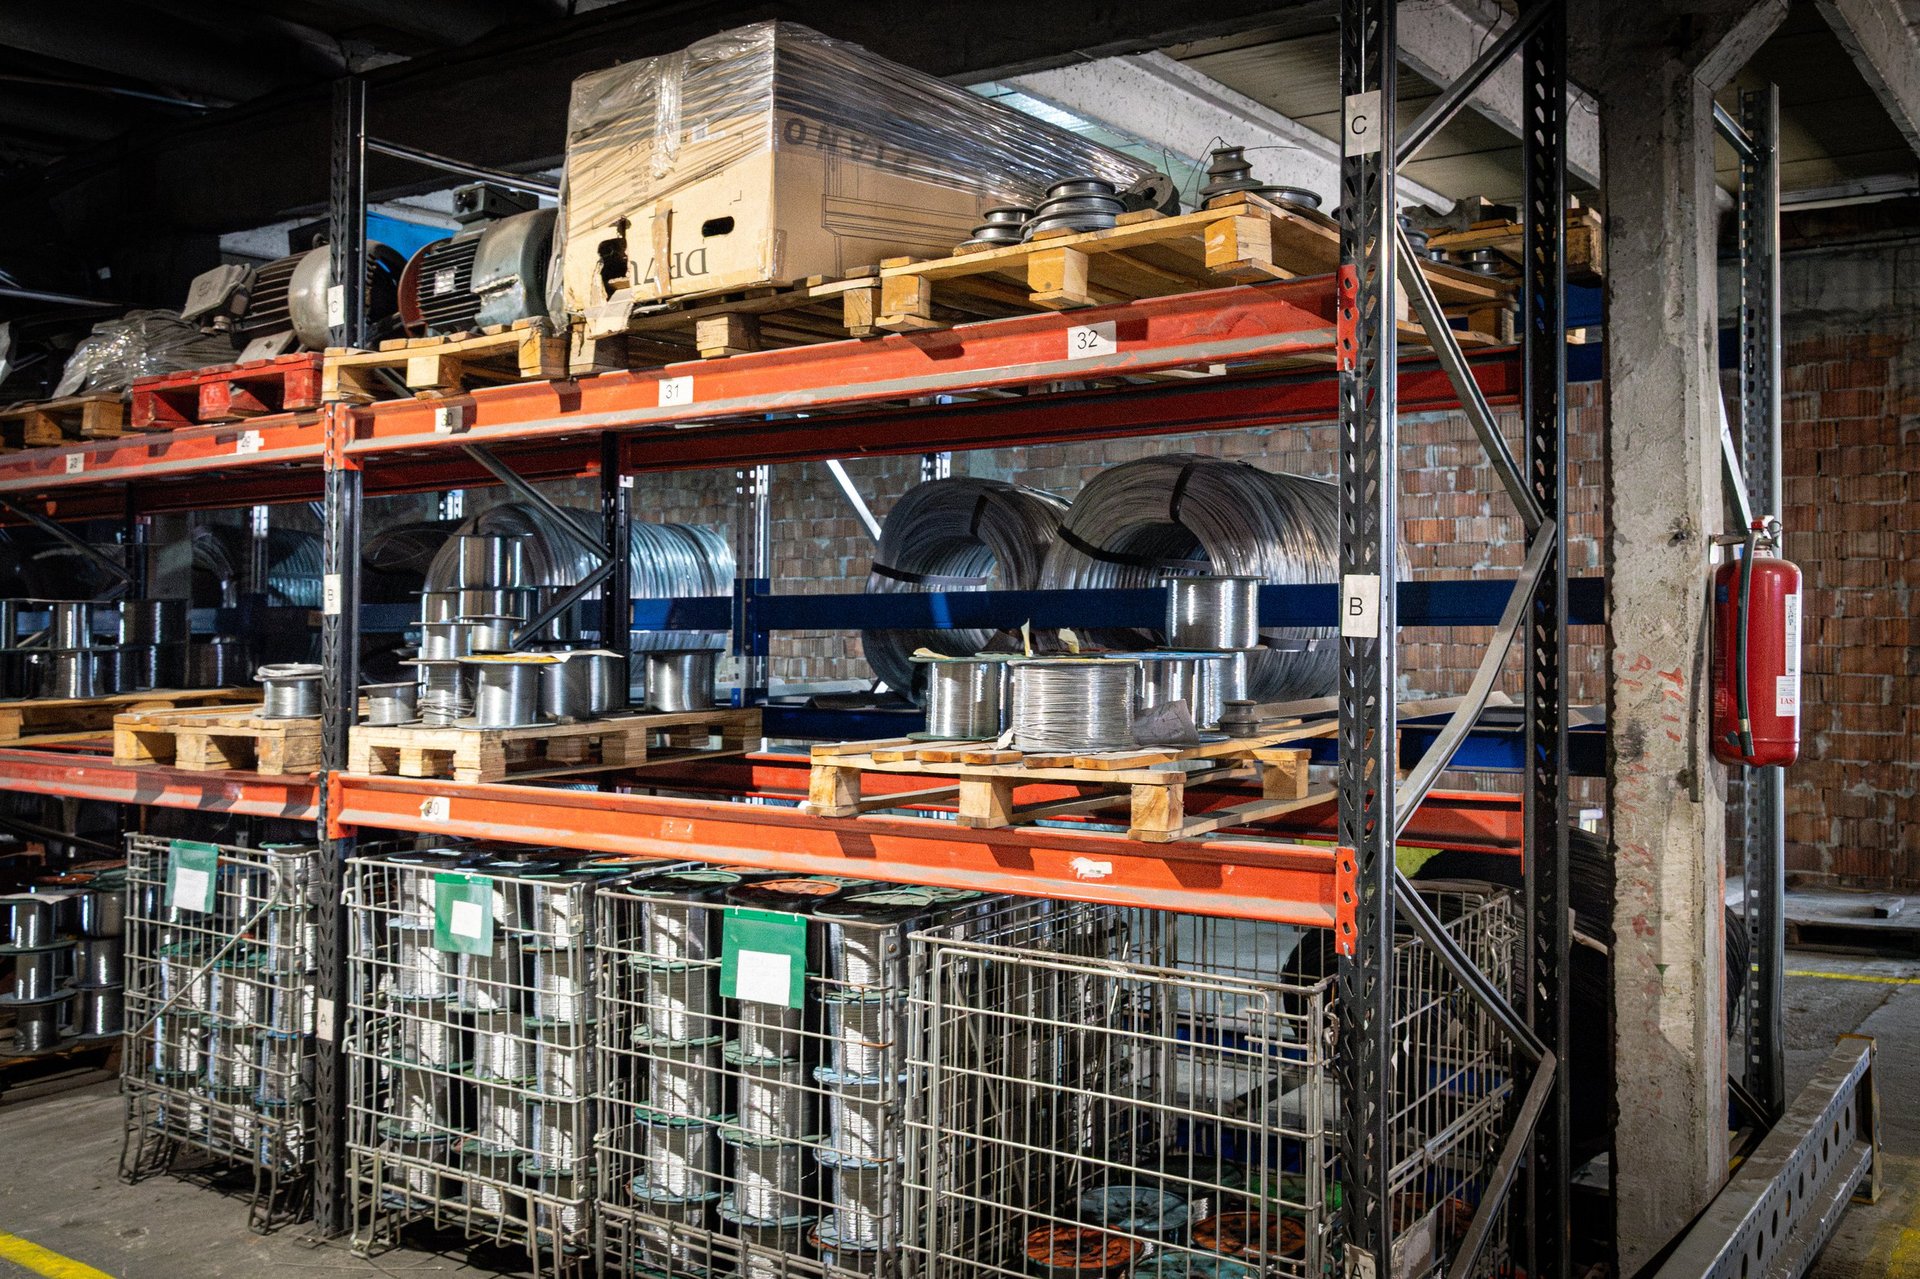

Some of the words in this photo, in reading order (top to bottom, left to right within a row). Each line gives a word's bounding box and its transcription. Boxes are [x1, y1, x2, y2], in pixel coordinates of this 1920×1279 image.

[1351, 115, 1367, 135] C
[331, 300, 338, 313] C
[1077, 329, 1098, 350] 32
[665, 384, 679, 399] 31
[441, 412, 453, 426] 30
[1349, 596, 1363, 616] B
[320, 1013, 327, 1026] A
[1351, 1262, 1363, 1279] A
